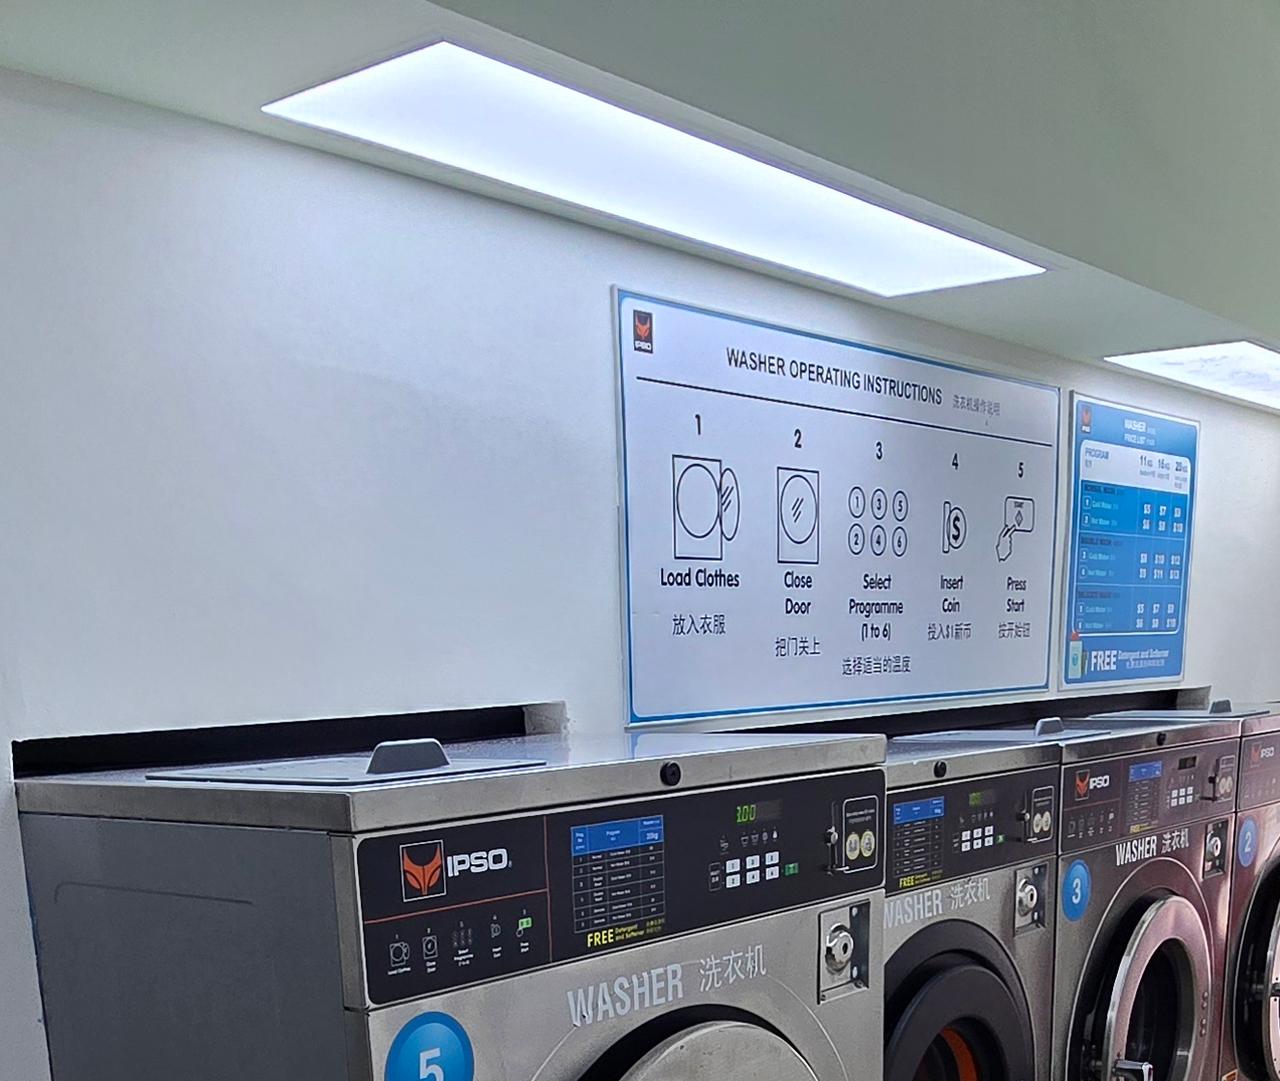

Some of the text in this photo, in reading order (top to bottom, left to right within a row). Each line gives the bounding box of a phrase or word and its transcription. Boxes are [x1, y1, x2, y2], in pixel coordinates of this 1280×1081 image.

[726, 347, 786, 376] WASHER
[789, 359, 860, 390] OPERATING
[863, 375, 942, 405] INSTRUCTIONS
[695, 414, 702, 435] 1
[794, 429, 802, 448] 2
[876, 442, 883, 460] 3
[951, 453, 959, 471] 4
[1018, 462, 1024, 478] 5
[876, 498, 882, 511] 3
[854, 533, 859, 546] 2
[661, 567, 740, 587] Load Clothes
[784, 571, 812, 588] Close
[863, 574, 891, 589] Select
[941, 575, 963, 590] Insert
[1007, 577, 1026, 591] Press
[785, 598, 811, 614] Door
[849, 599, 903, 618] Programme
[942, 598, 960, 612] Coin
[1007, 599, 1024, 612] Start
[672, 614, 726, 635] 放入衣服
[862, 623, 891, 641] (1 to 6)
[775, 636, 821, 657] 把门关上
[842, 655, 911, 676] 选择适当的温度
[1091, 650, 1117, 671] FREE
[1089, 775, 1109, 789] IPSO
[1116, 828, 1189, 866] WASHER 洗衣机
[1245, 831, 1252, 853] 2
[447, 848, 508, 877] IPSO
[951, 877, 990, 910] 洗衣机
[1072, 878, 1081, 905] 3
[587, 928, 614, 947] FREE
[567, 944, 767, 1027] WASHER 洗衣机
